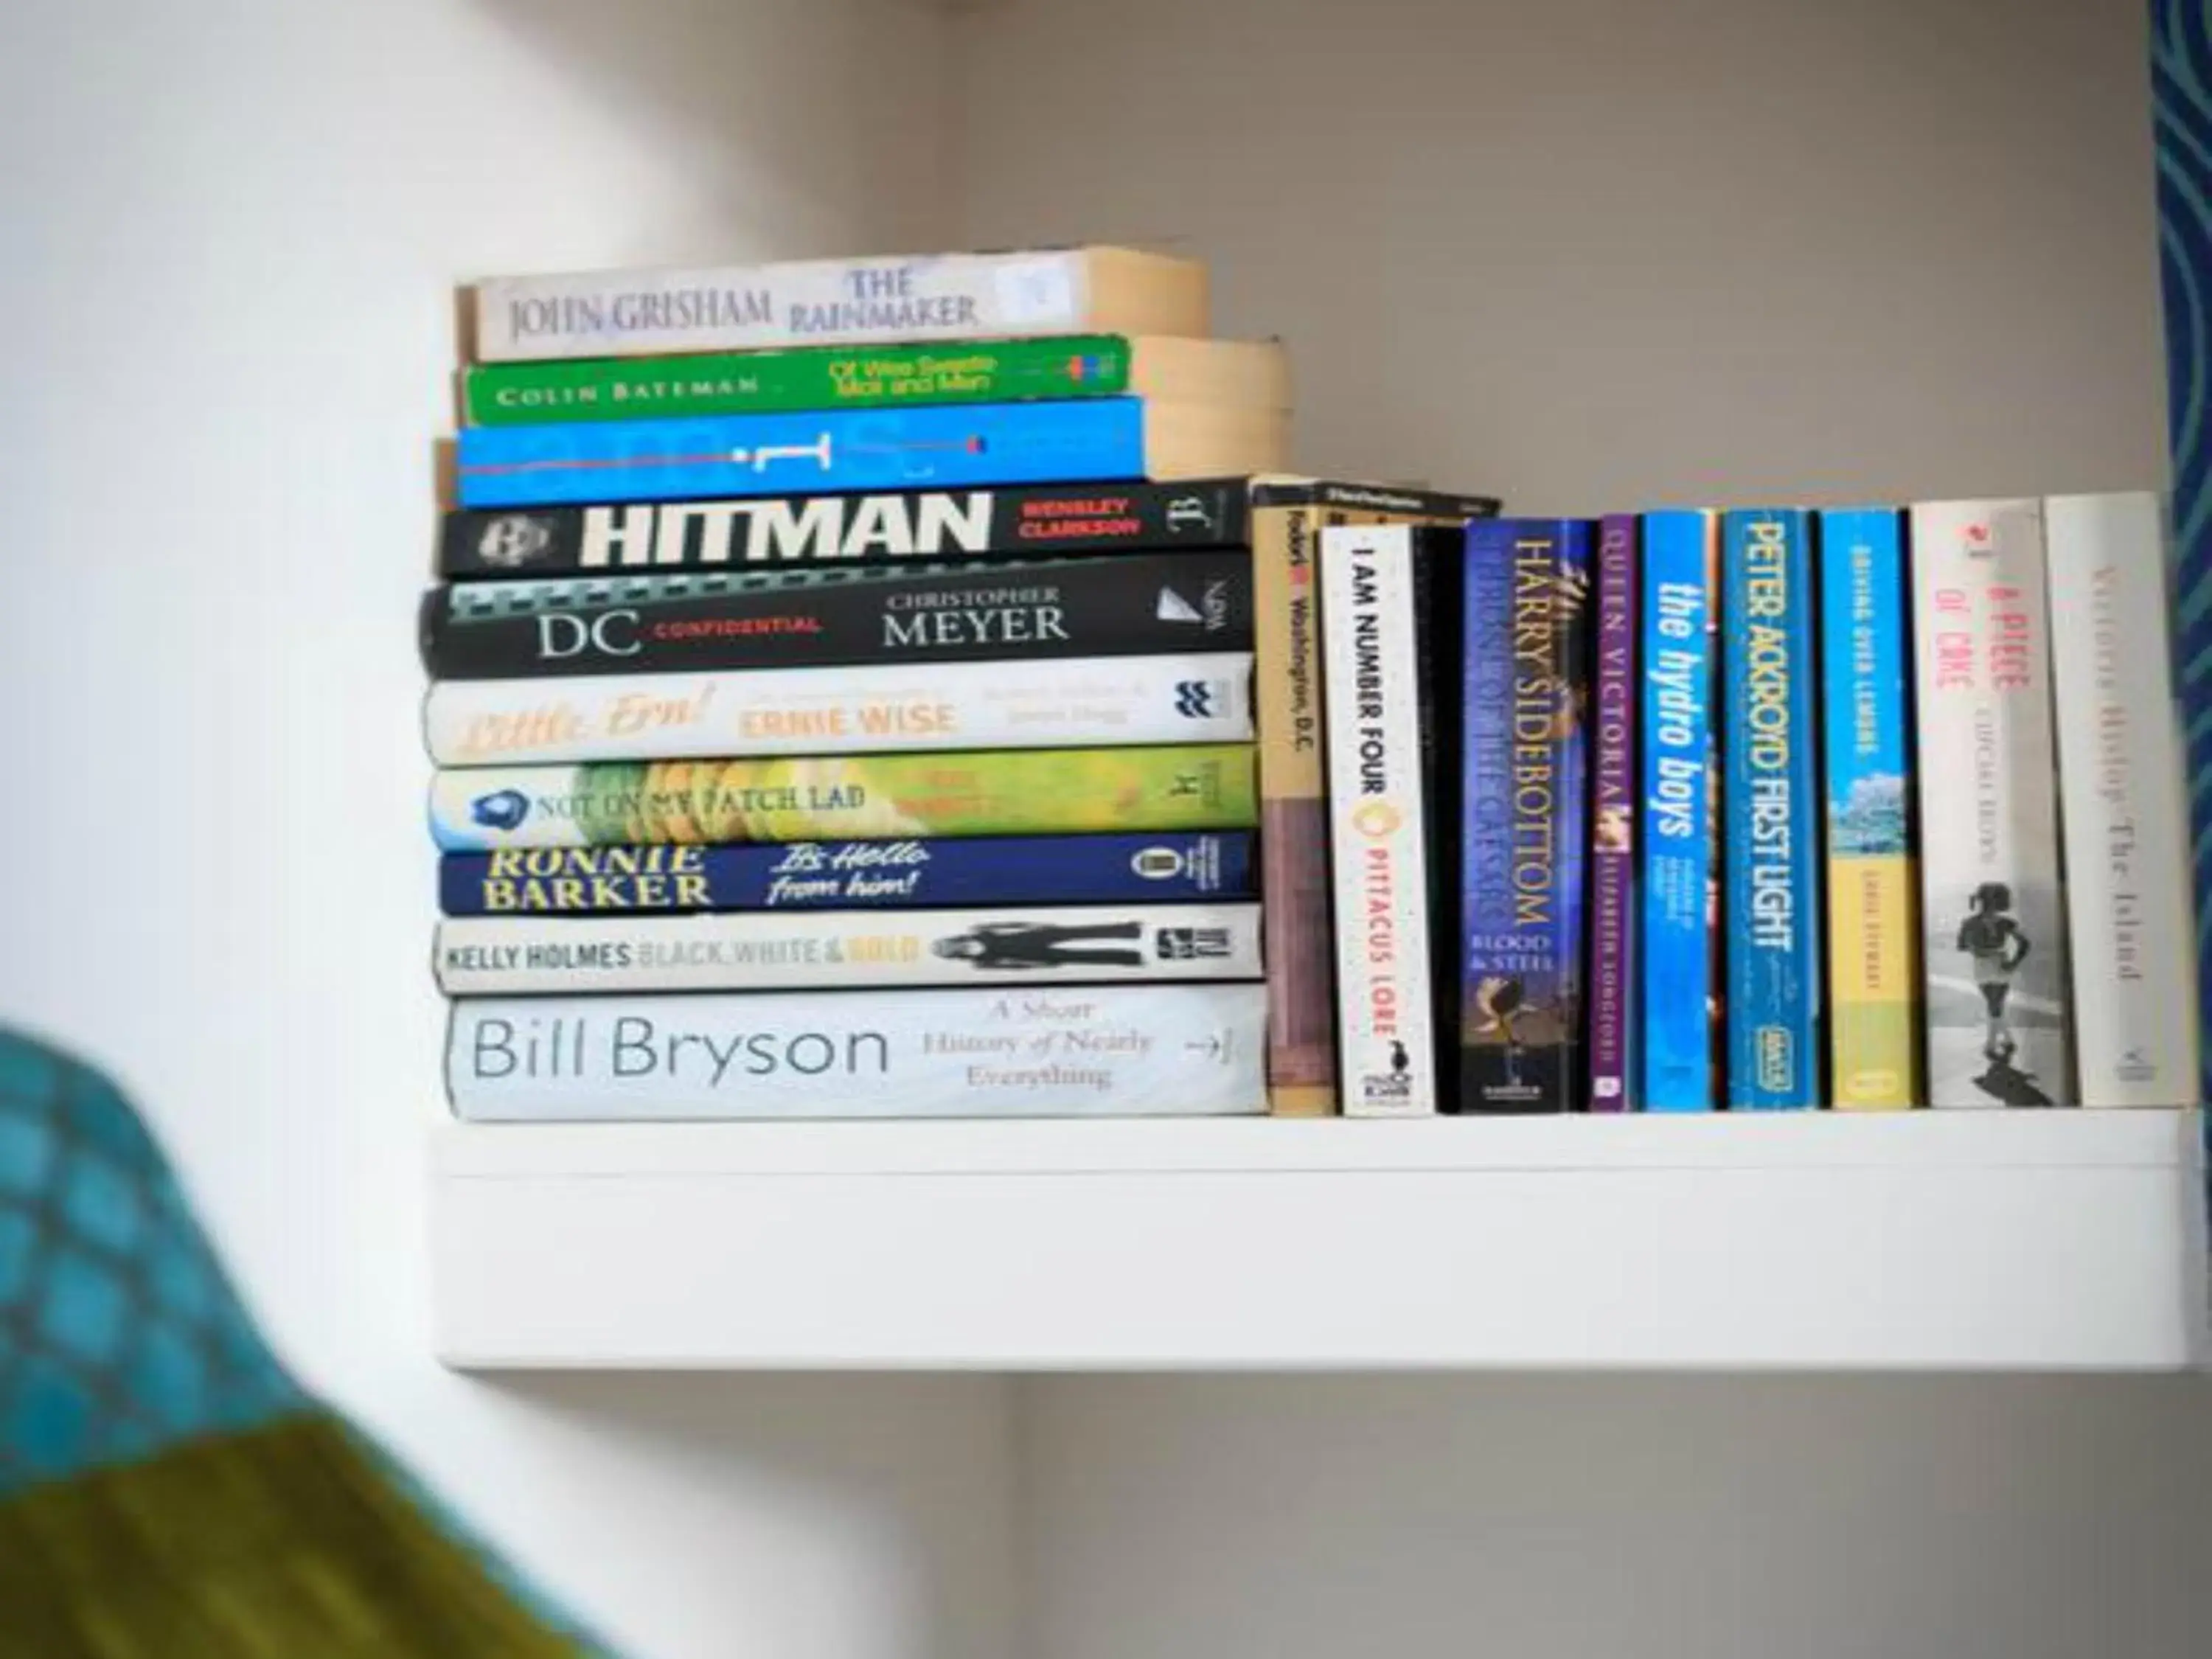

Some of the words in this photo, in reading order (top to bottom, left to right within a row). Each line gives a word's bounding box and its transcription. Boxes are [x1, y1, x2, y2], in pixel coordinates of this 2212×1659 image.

[852, 268, 913, 297] THE
[509, 295, 602, 340] JOHN
[611, 288, 773, 331] GRISHAM
[789, 296, 978, 334] RAINMAKER
[495, 387, 598, 407] COLIN
[612, 375, 759, 401] BATEMAN
[579, 492, 994, 568] HITMAN
[1018, 518, 1142, 539] CLARKSON
[1021, 497, 1130, 518] WENSLEY
[1351, 548, 1374, 556] I
[1600, 529, 1628, 630] QUEEN
[1746, 522, 1786, 618] PETER
[886, 586, 1061, 611] CHRISTOPHER
[1351, 565, 1380, 607] AM
[1514, 539, 1553, 658] HARRY
[1658, 582, 1705, 639] the
[1851, 545, 1873, 622] DRIVING
[1986, 585, 2020, 601] A
[538, 609, 642, 658] DC
[653, 616, 825, 639] CONFIDENTIAL
[882, 606, 1071, 648] MEYER
[1852, 626, 1875, 673] OVER
[1989, 613, 2032, 692] PIECE
[2091, 566, 2118, 690] Victoria
[1354, 614, 1384, 720] NUMBER
[1935, 632, 1974, 691] CAKE
[742, 706, 846, 738] ERNIE
[858, 702, 956, 734] WISE
[1599, 647, 1627, 799] VICTORIA
[1647, 650, 1705, 747] hydro
[1747, 626, 1790, 771] ACKROYD
[1854, 680, 1879, 756] LEMONS
[1360, 728, 1388, 796] FOUR
[2096, 705, 2131, 803] Hislop
[536, 792, 595, 818] NOT
[704, 786, 798, 812] PATCH
[810, 785, 866, 810] LAD
[1512, 677, 1554, 926] SIDEBOTTOM
[1647, 757, 1705, 838] boys
[1750, 777, 1792, 859] FIRST
[487, 844, 706, 879] RONNIE
[830, 840, 931, 870] Hello
[2107, 817, 2135, 875] The
[482, 874, 714, 911] BARKER
[765, 874, 840, 905] from
[846, 869, 922, 897] him!
[1365, 849, 1395, 964] PITTACUS
[1600, 856, 1620, 953] ELIZABETH
[1752, 866, 1793, 952] LIGHT
[447, 944, 519, 972] KELLY
[525, 942, 630, 970] HOLMES
[734, 936, 816, 965] WHITE
[819, 933, 845, 964] &
[847, 933, 919, 964] GOLD
[1470, 935, 1551, 951] BLOOD
[1490, 952, 1554, 972] STEEL
[1864, 922, 1882, 990] STEWART
[2113, 893, 2145, 982] Island
[989, 1000, 1010, 1020] A
[1023, 997, 1096, 1020] Short
[1369, 978, 1397, 1037] LORE
[473, 1016, 585, 1079] Bill
[612, 1015, 888, 1089] Bryson
[922, 1031, 1017, 1057] History
[1024, 1031, 1057, 1054] of
[1062, 1028, 1156, 1056] Nearly
[966, 1065, 1113, 1091] Everything
